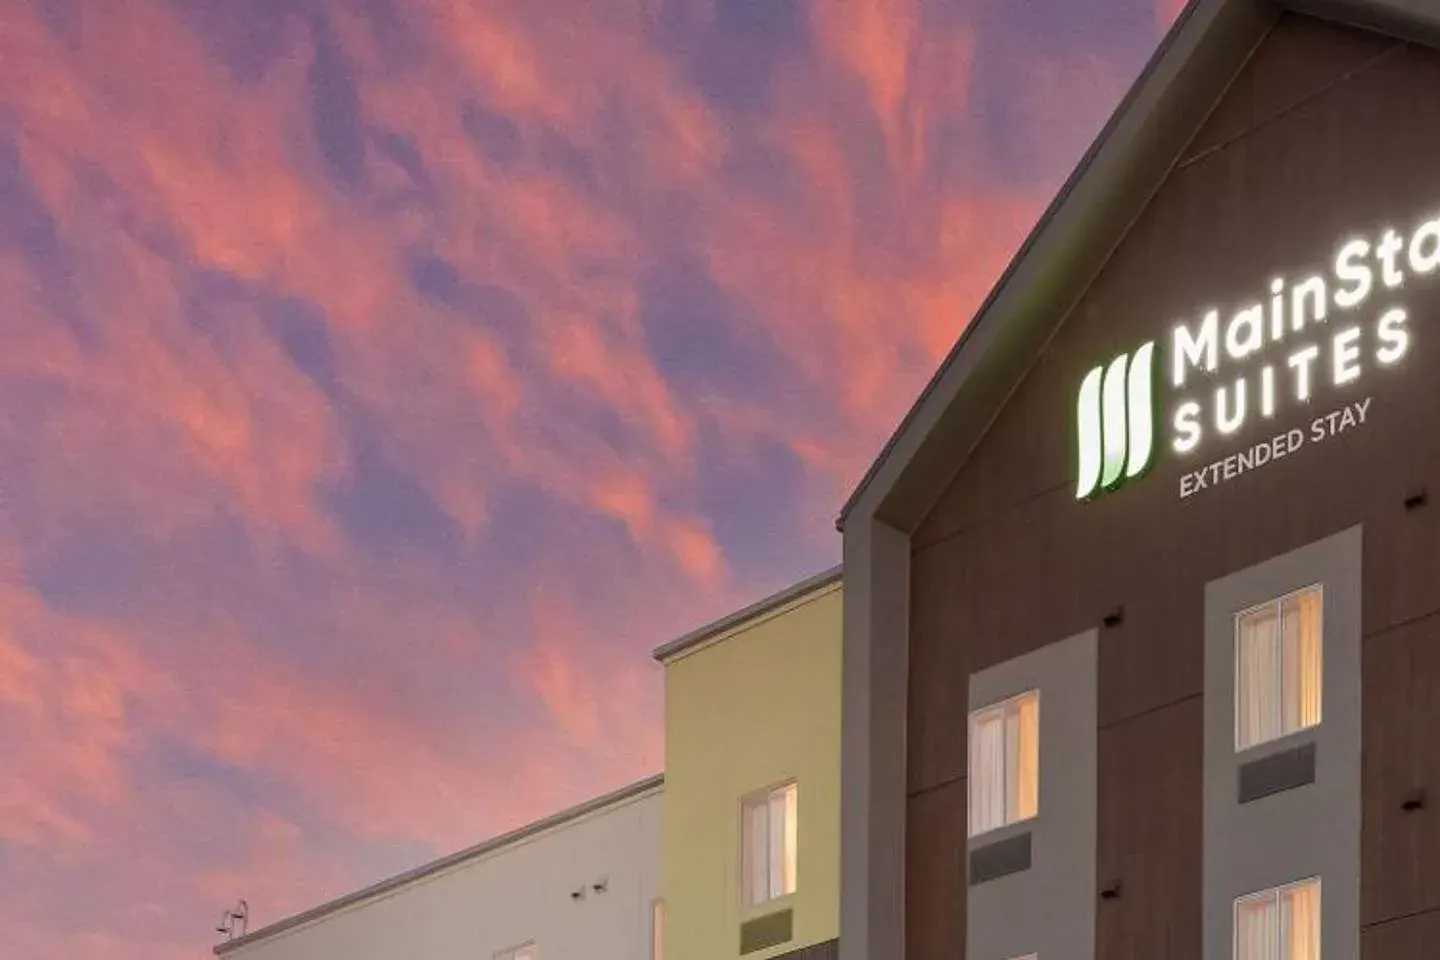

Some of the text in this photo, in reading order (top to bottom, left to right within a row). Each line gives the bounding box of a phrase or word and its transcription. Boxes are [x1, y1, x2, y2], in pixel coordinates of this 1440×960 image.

[1173, 308, 1410, 452] SUITES
[1179, 398, 1373, 498] EXTENDED STAY
